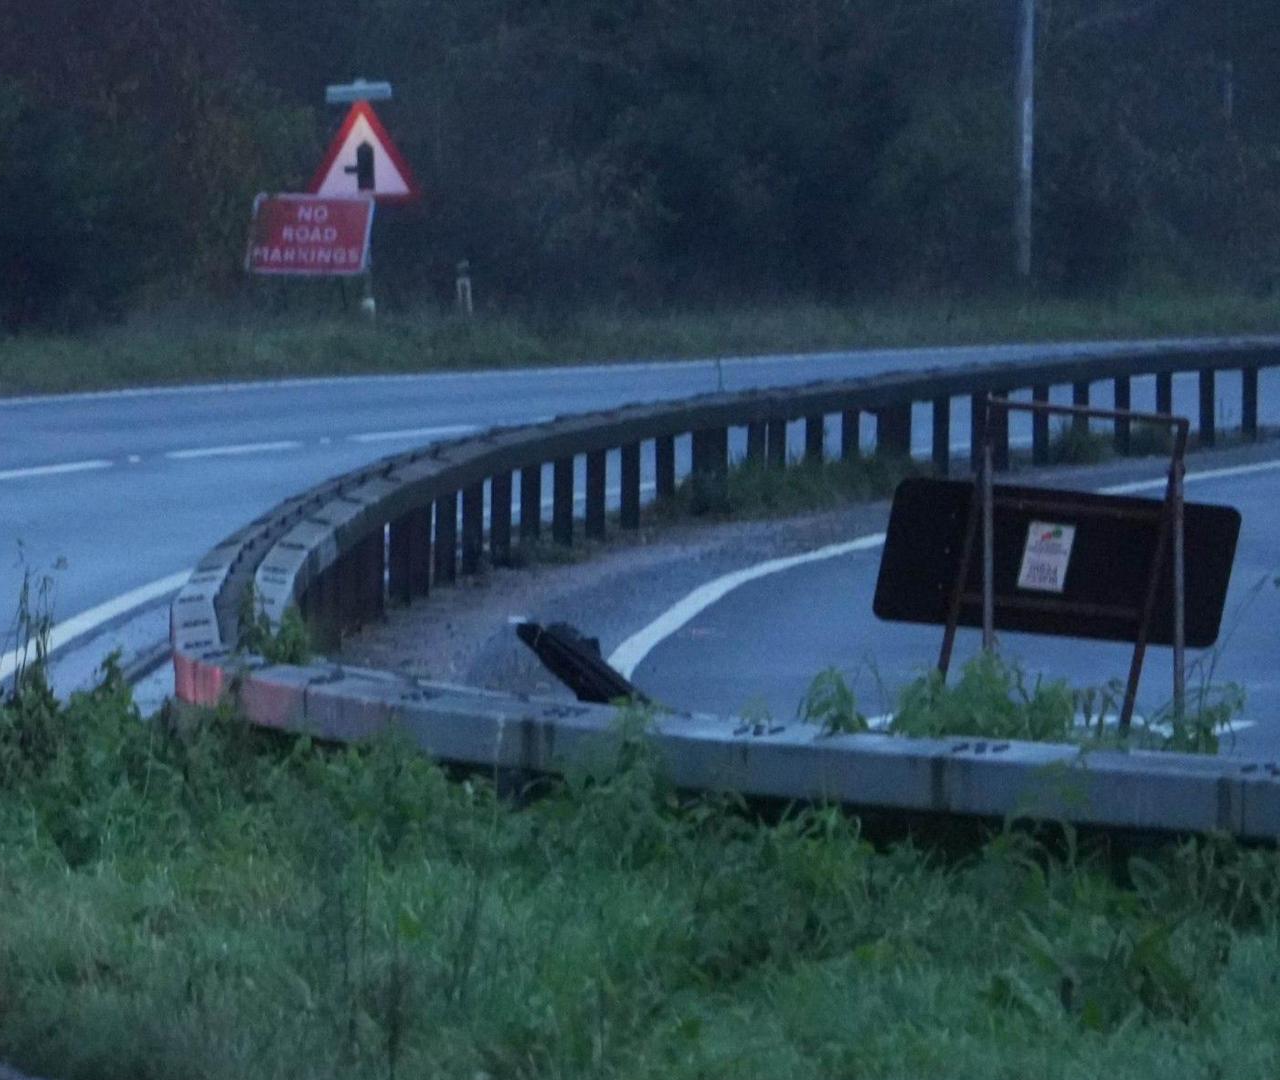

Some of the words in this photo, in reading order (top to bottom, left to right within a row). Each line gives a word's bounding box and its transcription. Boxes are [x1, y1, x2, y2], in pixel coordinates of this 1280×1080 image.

[298, 204, 328, 222] NO
[282, 224, 337, 243] ROAD
[253, 246, 359, 263] MARKINGS
